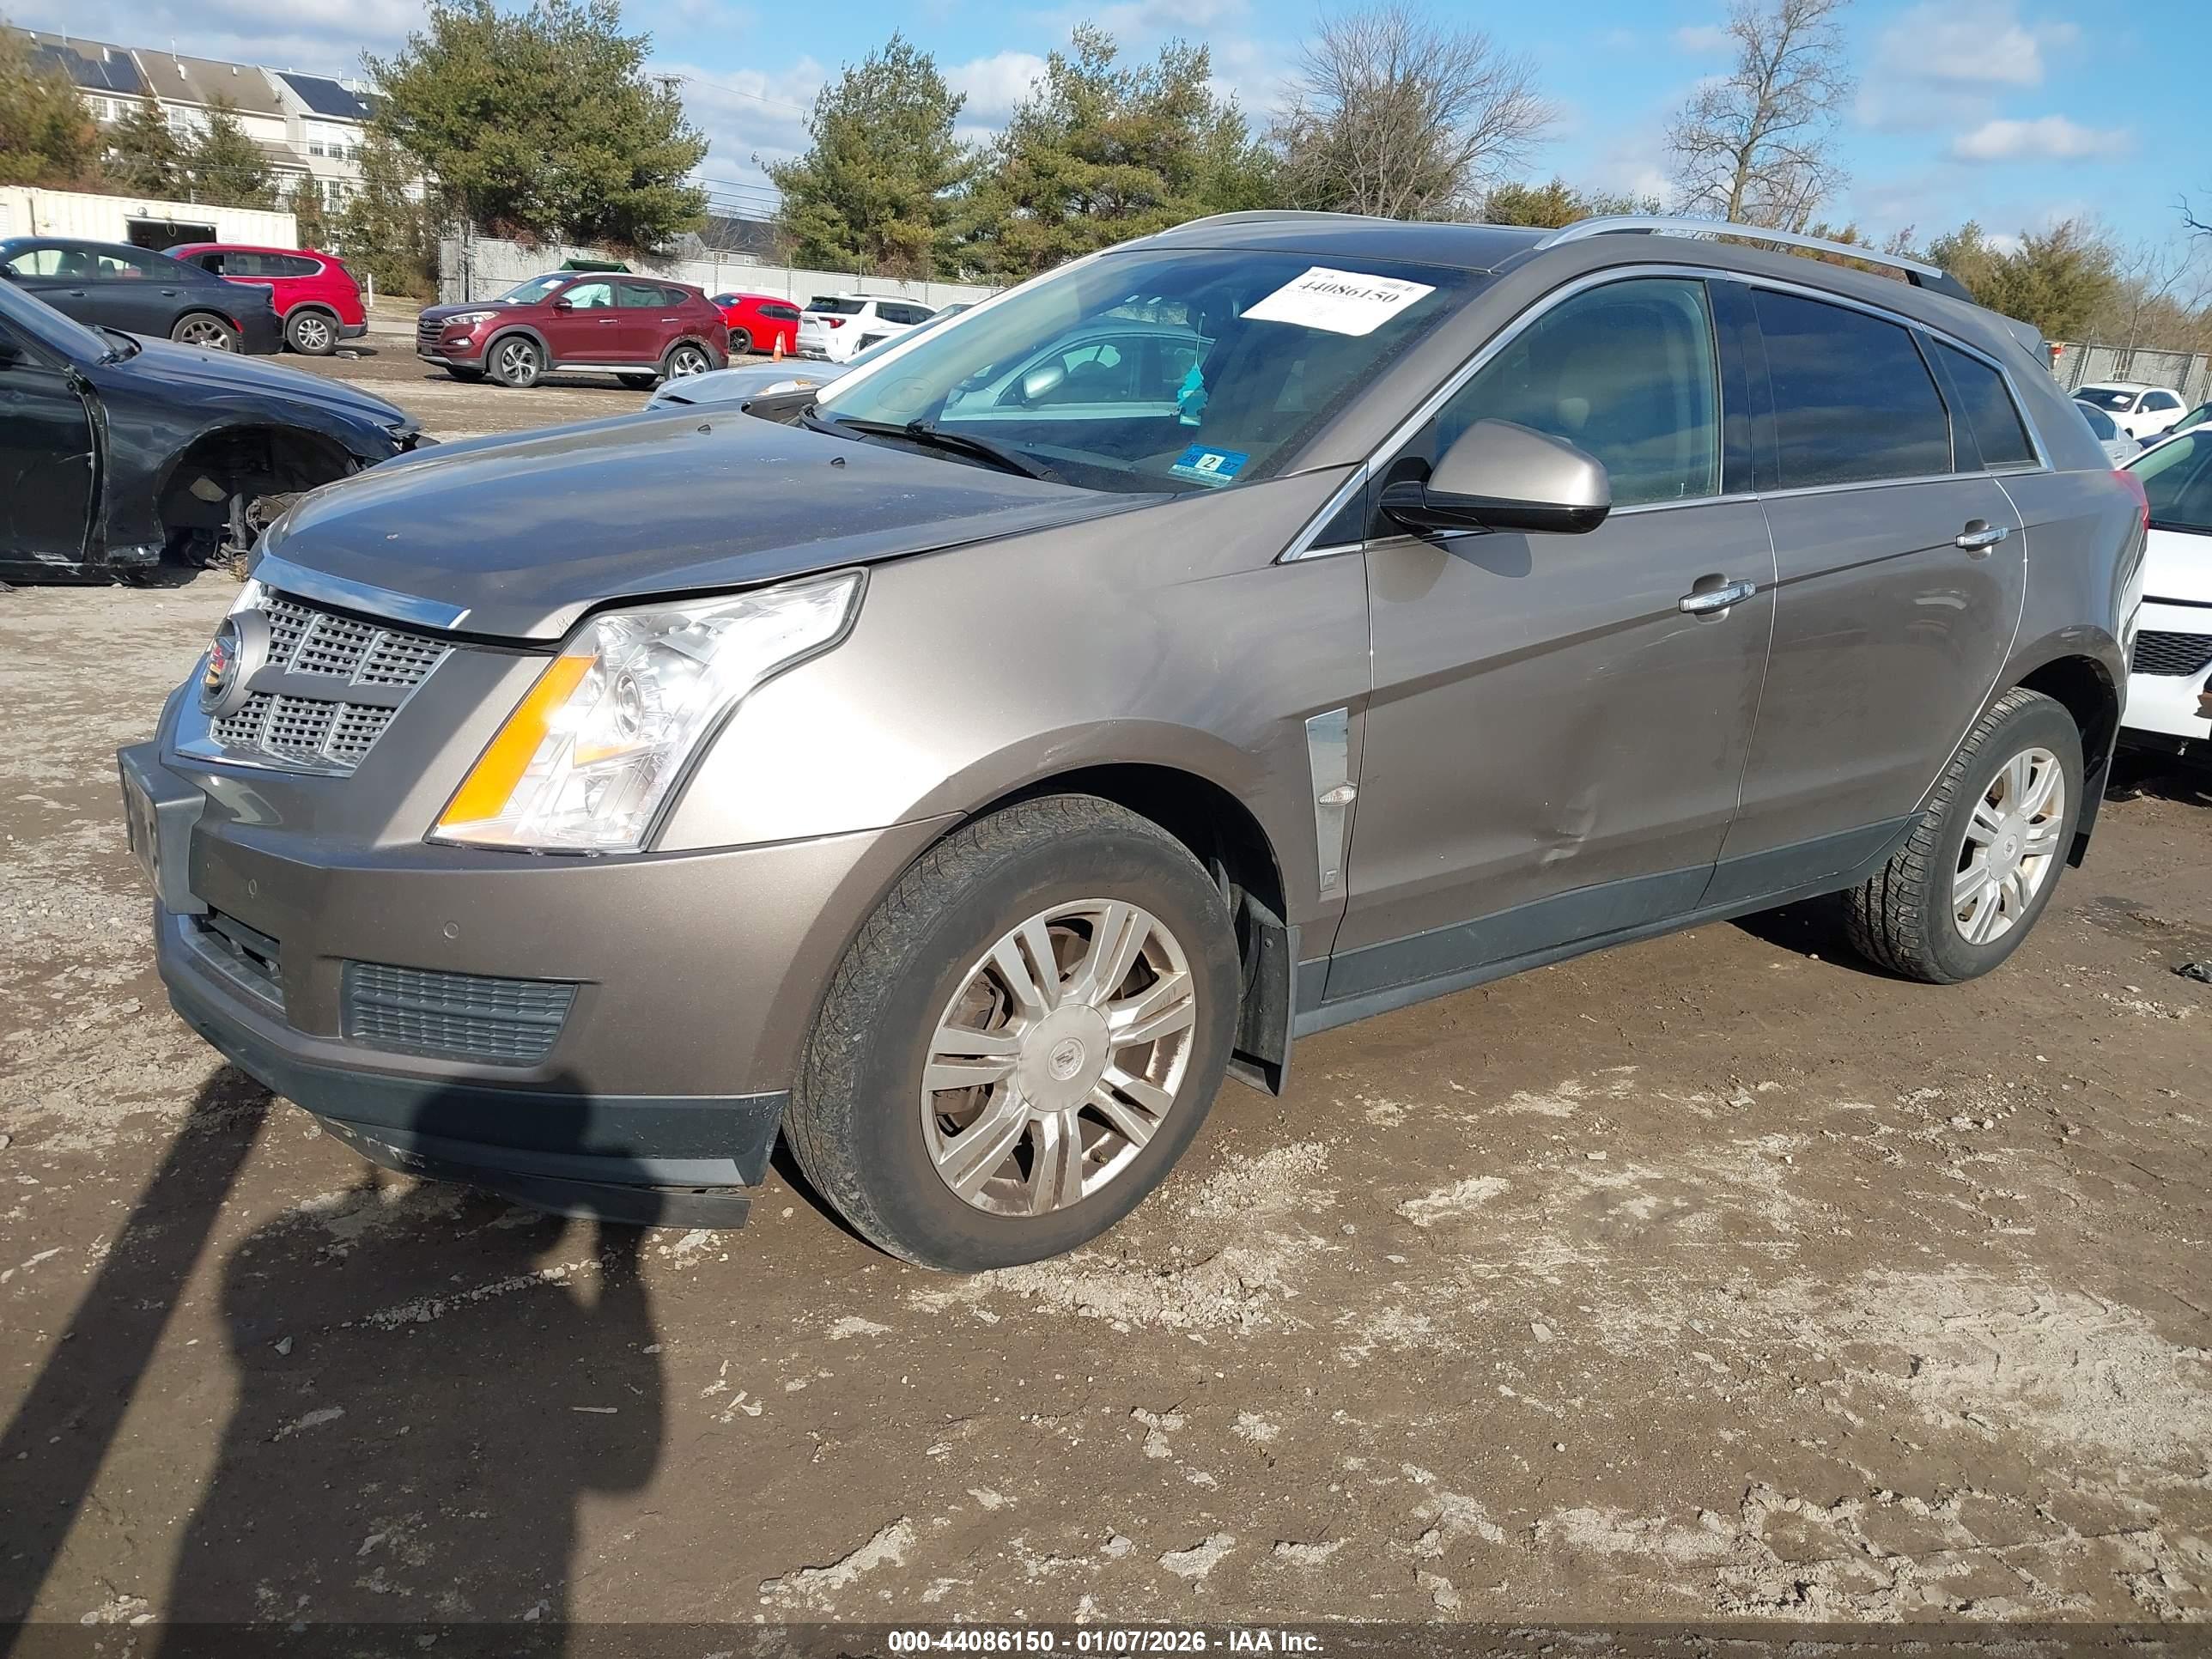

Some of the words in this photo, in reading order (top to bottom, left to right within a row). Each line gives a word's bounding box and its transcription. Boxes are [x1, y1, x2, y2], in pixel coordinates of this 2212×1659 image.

[1298, 281, 1401, 303] 44086150
[1182, 453, 1199, 462] 20
[1203, 457, 1217, 469] 2
